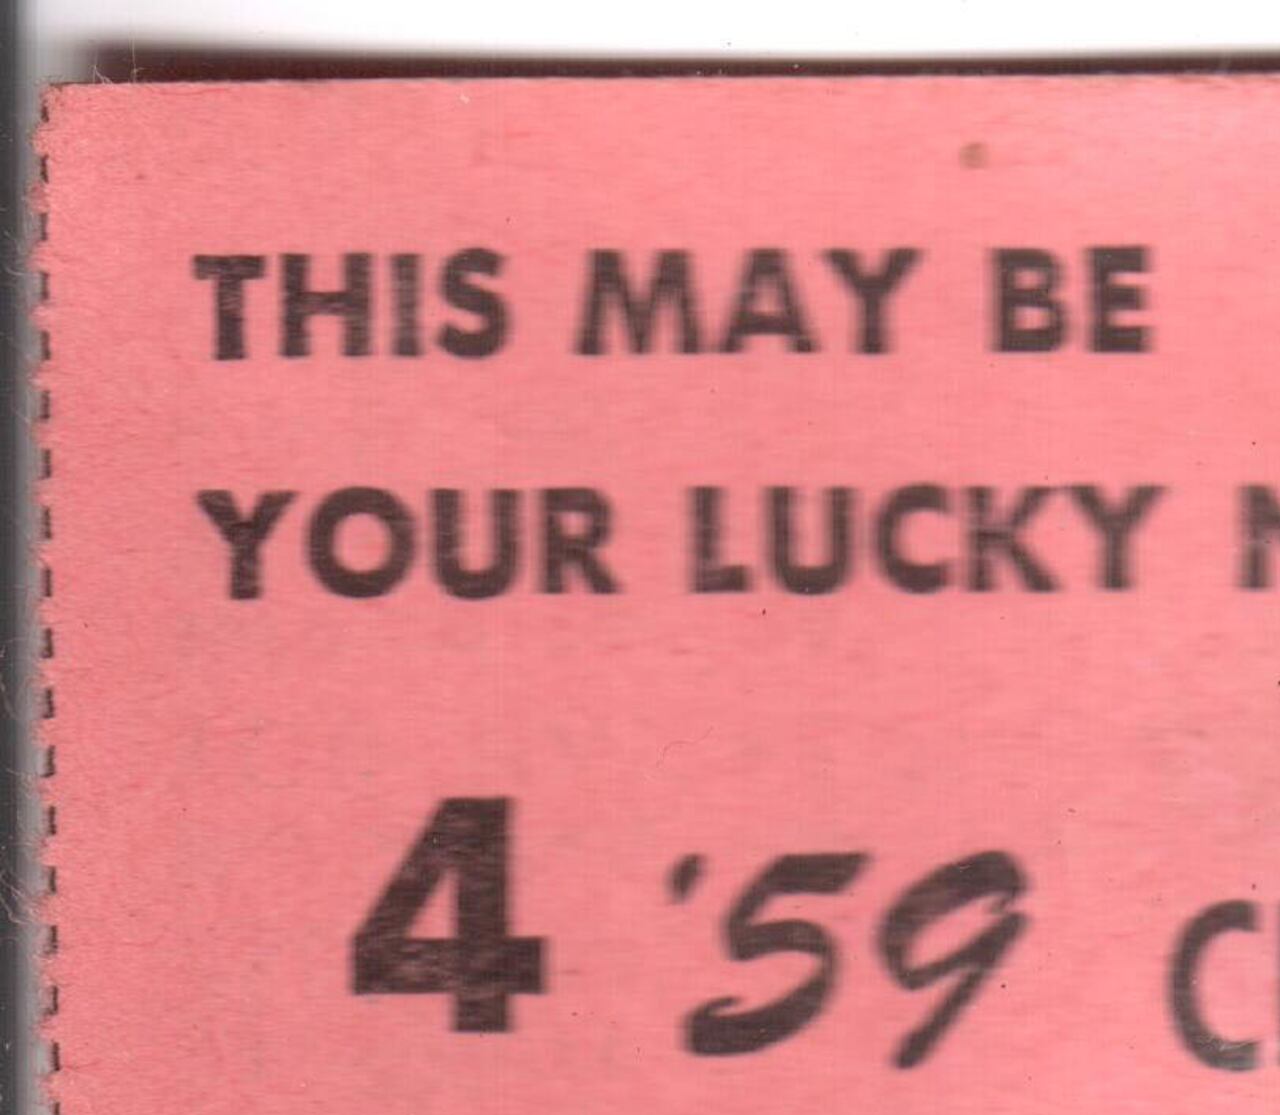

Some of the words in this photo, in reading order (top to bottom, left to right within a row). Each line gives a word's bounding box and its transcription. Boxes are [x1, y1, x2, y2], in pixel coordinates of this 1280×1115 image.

[191, 247, 510, 362] THIS
[575, 248, 919, 357] MAY
[992, 246, 1148, 354] BE
[196, 485, 618, 602] YOUR
[691, 483, 1159, 597] LUCKY
[349, 796, 548, 1035] 4
[669, 850, 1028, 1070] '59
